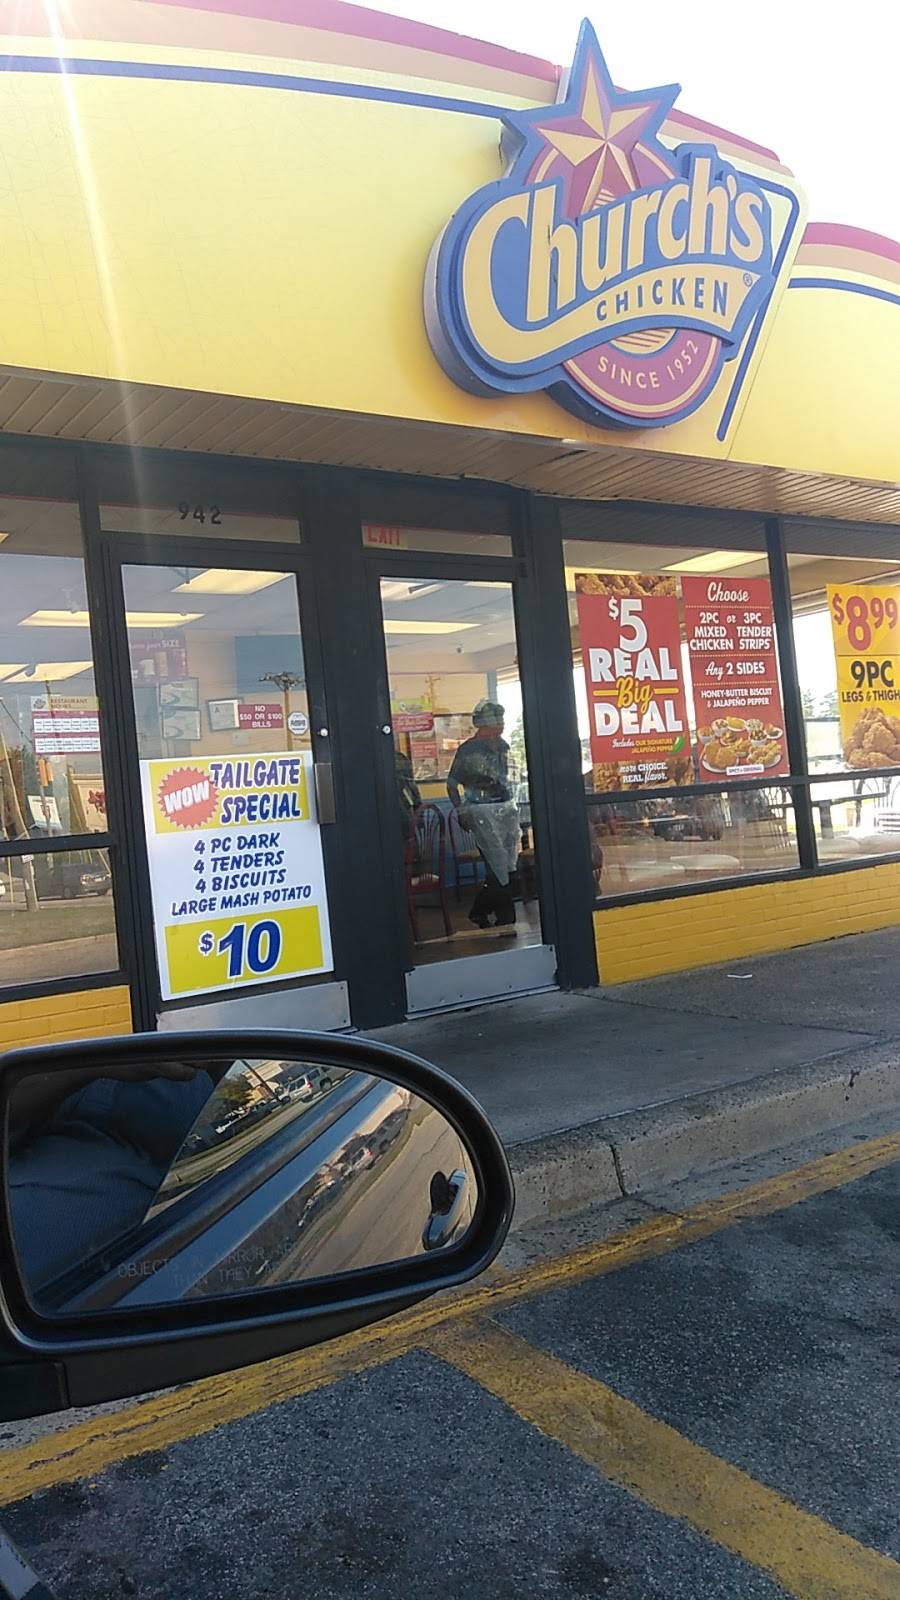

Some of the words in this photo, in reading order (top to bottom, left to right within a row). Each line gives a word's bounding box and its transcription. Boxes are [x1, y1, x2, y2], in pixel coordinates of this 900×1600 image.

[462, 157, 764, 363] Church's
[596, 277, 729, 321] CHICKEN
[598, 356, 660, 389] SINCE
[668, 339, 699, 381] 1952
[178, 502, 222, 525] 942
[707, 581, 750, 602] Choose
[608, 595, 648, 653] $5
[700, 612, 719, 624] 2PC
[726, 614, 736, 623] or
[743, 612, 762, 624] 3PC
[689, 638, 734, 650] CHICKEN
[739, 638, 770, 650] STRIPS
[694, 626, 727, 638] MIXED
[736, 626, 772, 638] TENDER
[589, 647, 678, 682] REAL
[705, 660, 723, 680] Any
[726, 662, 734, 675] 2
[736, 662, 766, 675] SIDES
[851, 660, 894, 688] 9PC
[616, 677, 654, 714] Big
[701, 688, 749, 699] HONEY-BUTTER
[750, 688, 772, 696] BISCUIT
[747, 697, 770, 705] PEPPER
[842, 691, 864, 703] LEGS
[594, 700, 683, 736] DEAL
[210, 758, 301, 789] TAILGATE
[623, 775, 643, 784] REAL
[164, 780, 209, 812] WOW
[221, 793, 300, 823] SPECIAL
[194, 840, 205, 855] 4
[211, 837, 231, 853] PC
[237, 833, 280, 850] DARK
[193, 859, 204, 874] 4
[211, 851, 285, 872] TENDERS
[195, 879, 206, 893] 4
[212, 869, 286, 892] BISCUITS
[171, 897, 216, 916] LARGE
[220, 891, 259, 910] MASH
[263, 885, 312, 903] POTATO
